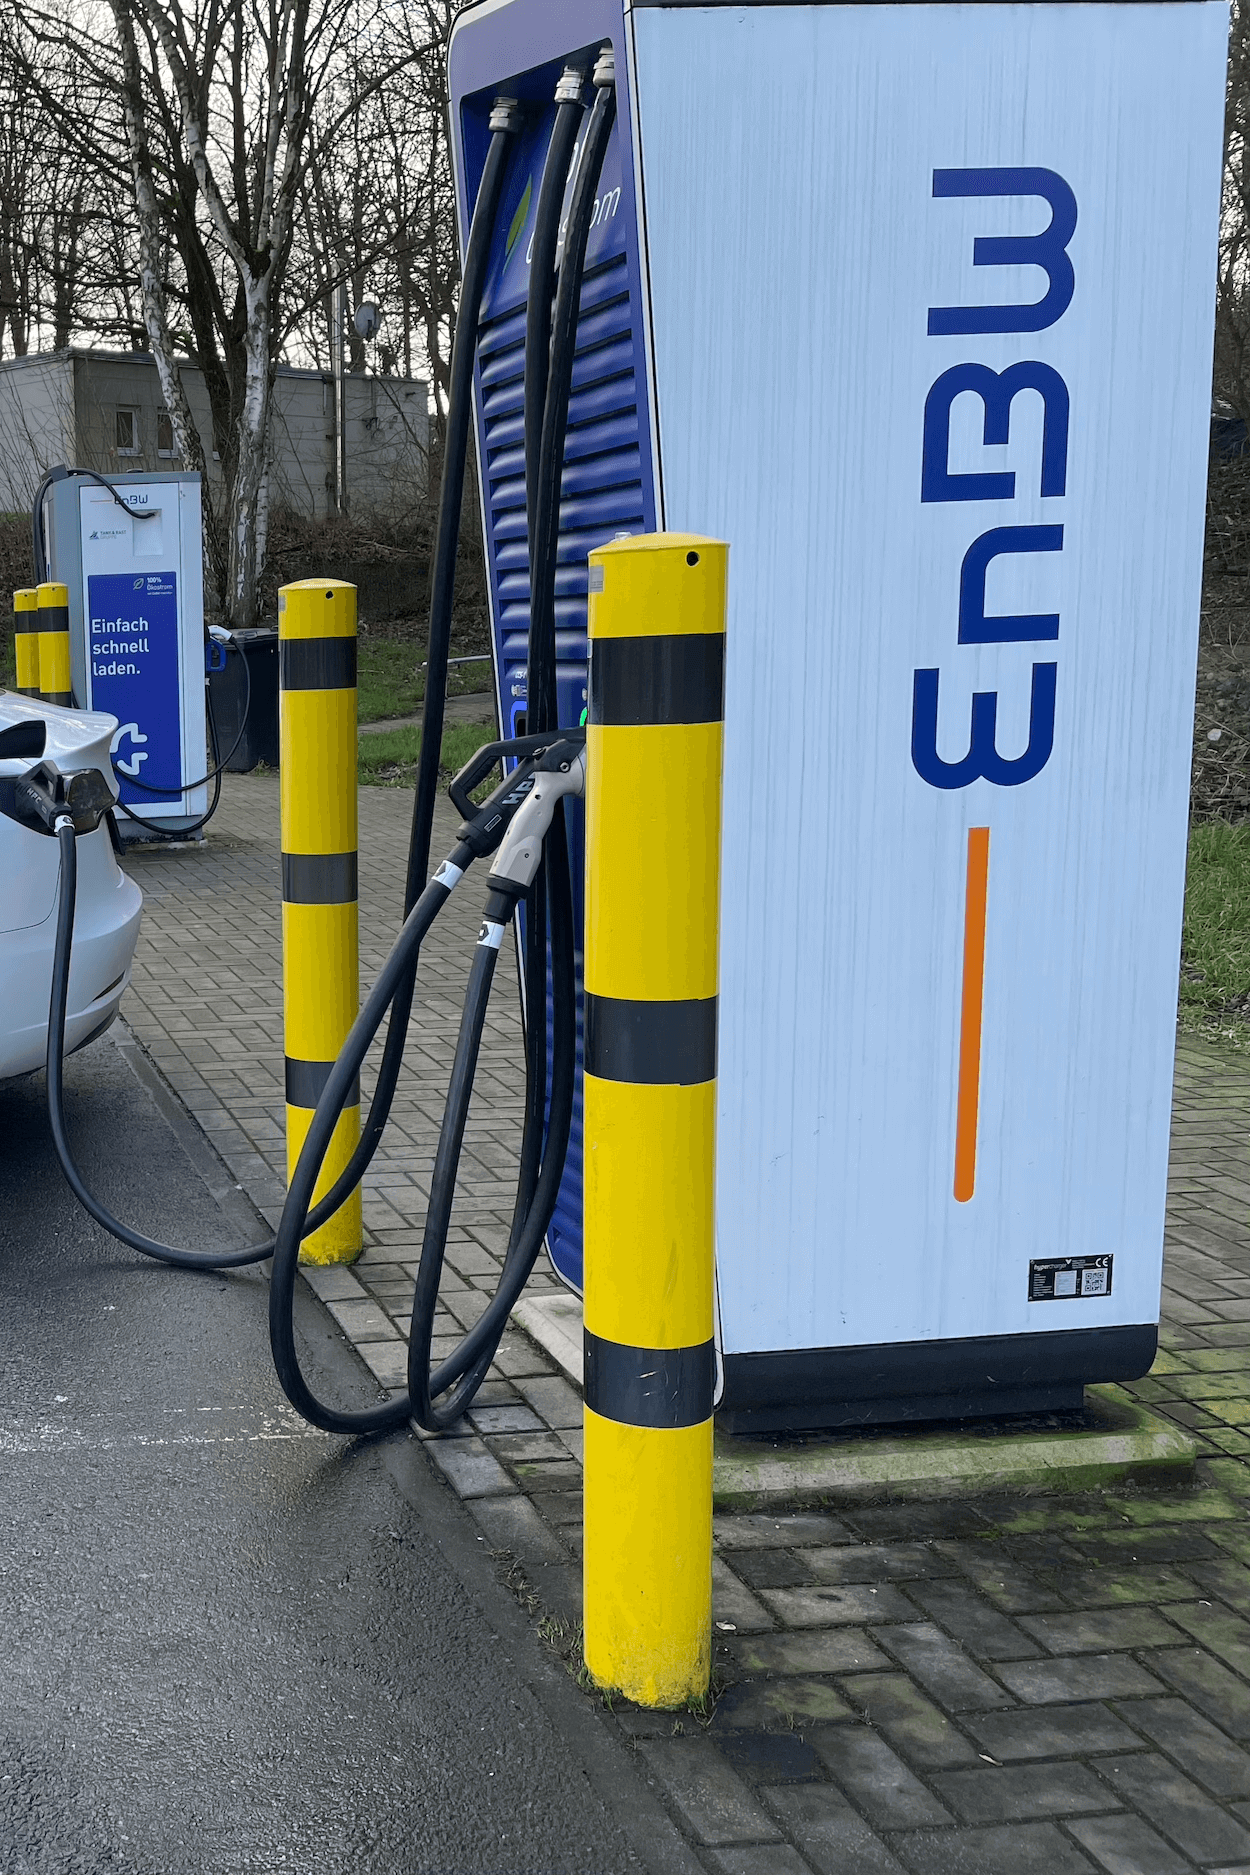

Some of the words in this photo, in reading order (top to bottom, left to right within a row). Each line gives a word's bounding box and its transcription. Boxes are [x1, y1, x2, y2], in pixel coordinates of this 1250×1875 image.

[911, 166, 1079, 790] EnBW
[146, 583, 174, 591] Ökostrom
[91, 616, 149, 633] Einfach
[92, 638, 150, 655] schnell
[93, 660, 141, 676] laden.
[26, 787, 43, 804] HPC
[501, 772, 536, 805] HP
